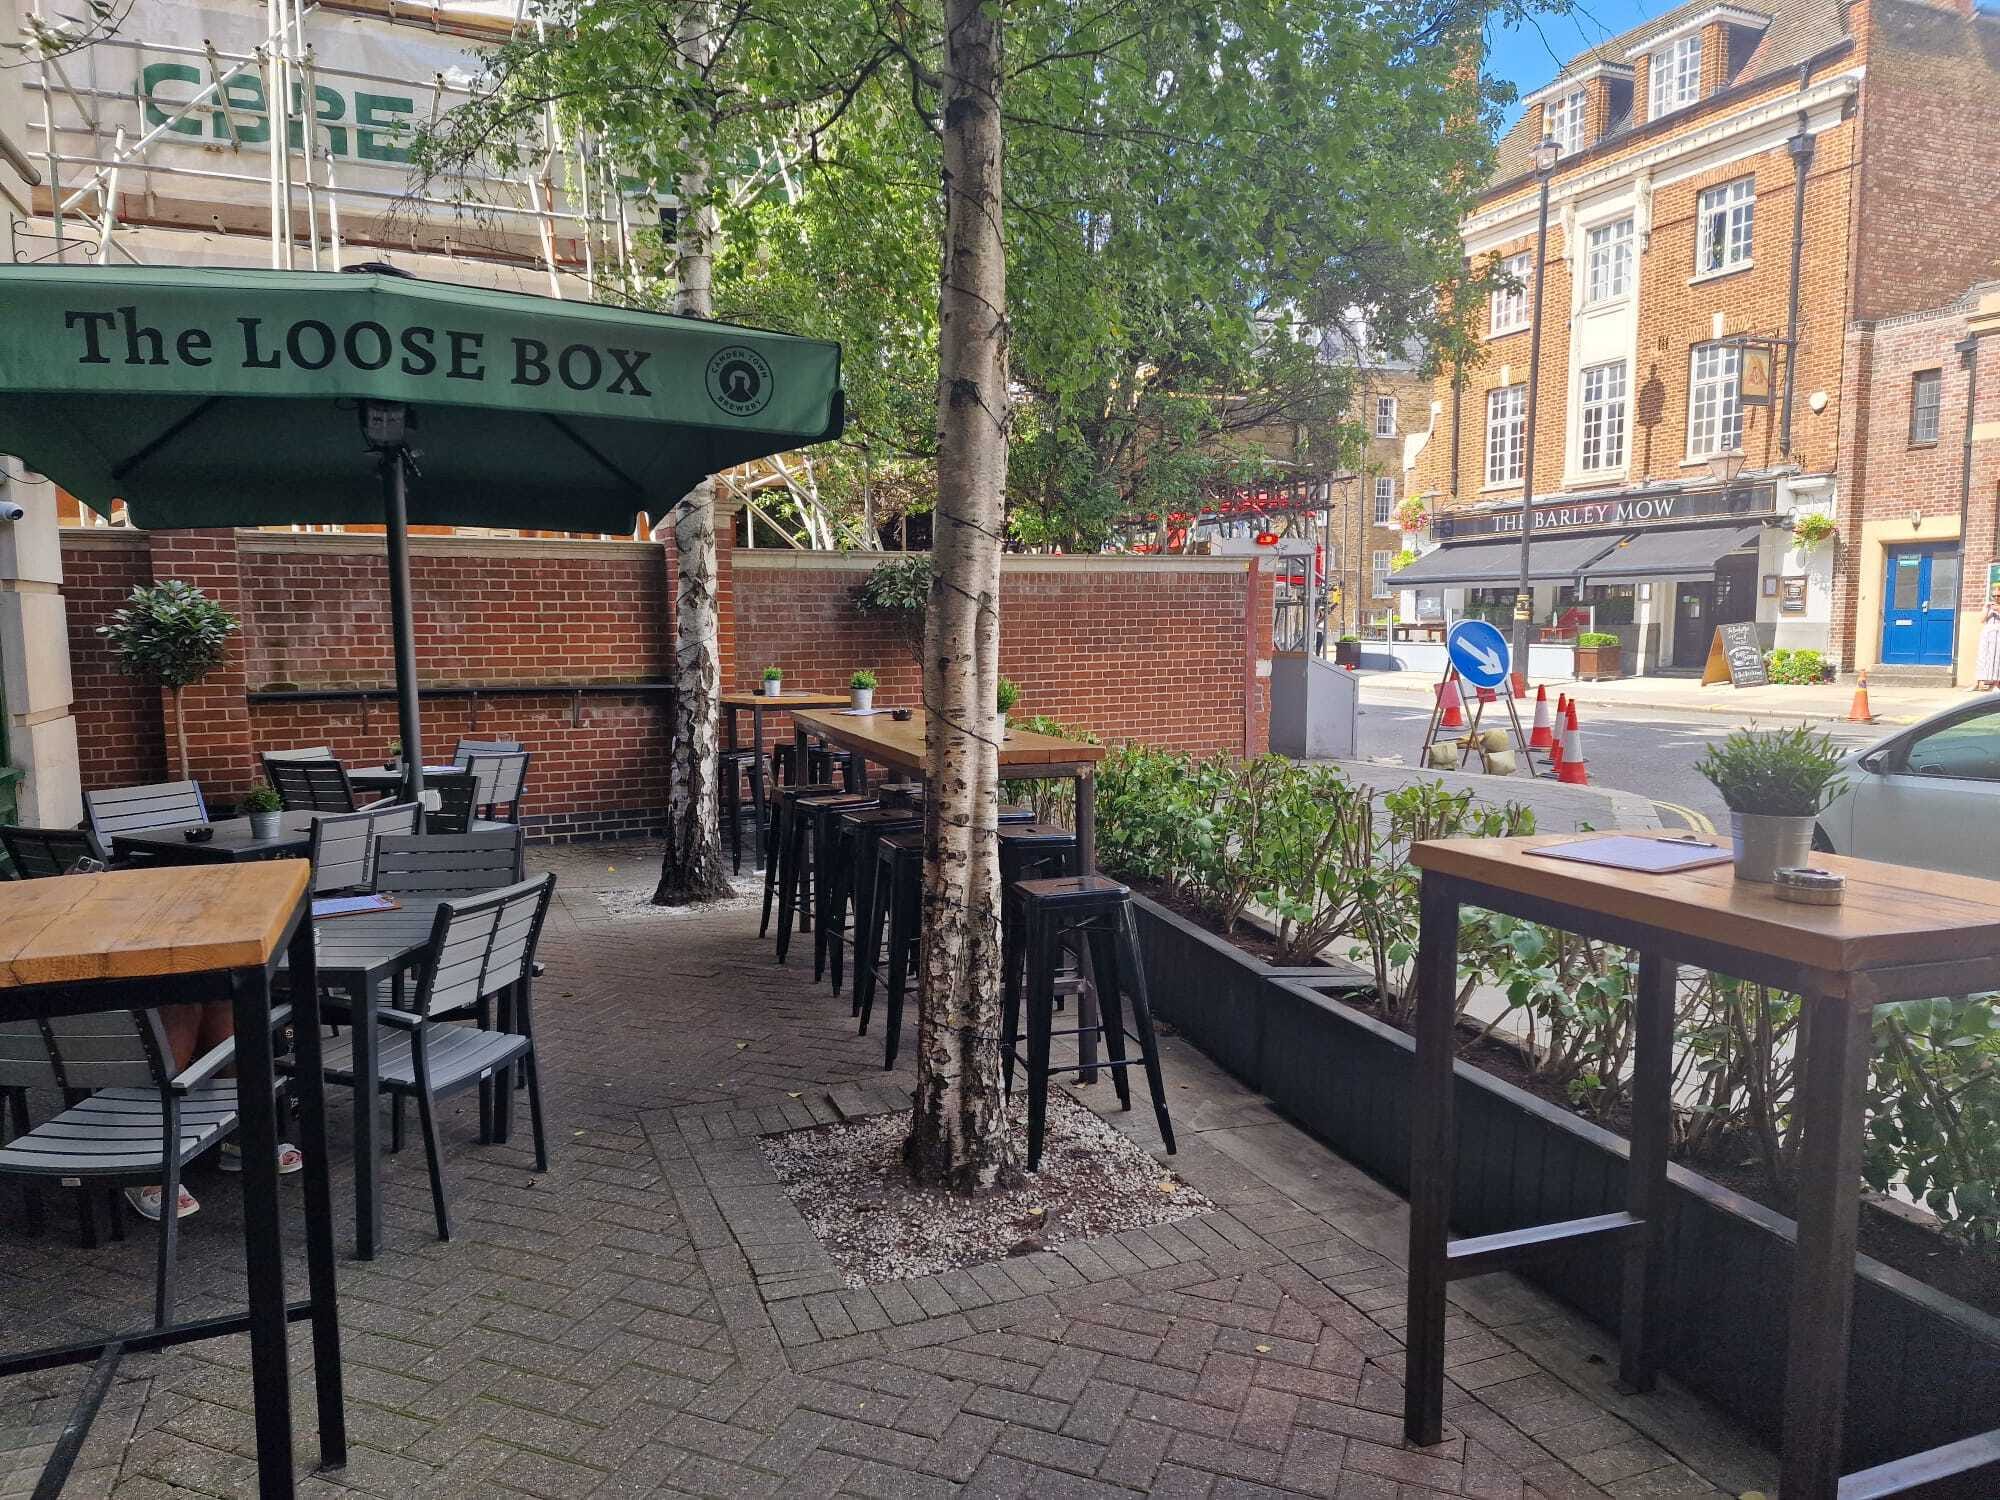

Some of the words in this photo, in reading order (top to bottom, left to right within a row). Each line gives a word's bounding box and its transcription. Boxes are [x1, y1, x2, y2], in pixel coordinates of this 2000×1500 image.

[135, 62, 413, 163] CBRE
[65, 305, 212, 367] The
[236, 317, 485, 381] LOOSE
[510, 337, 653, 396] BOX
[711, 350, 745, 374] CAMDEN
[718, 395, 761, 412] BREWERY
[1535, 504, 1608, 528] BARLEY
[1615, 498, 1676, 521] MOW
